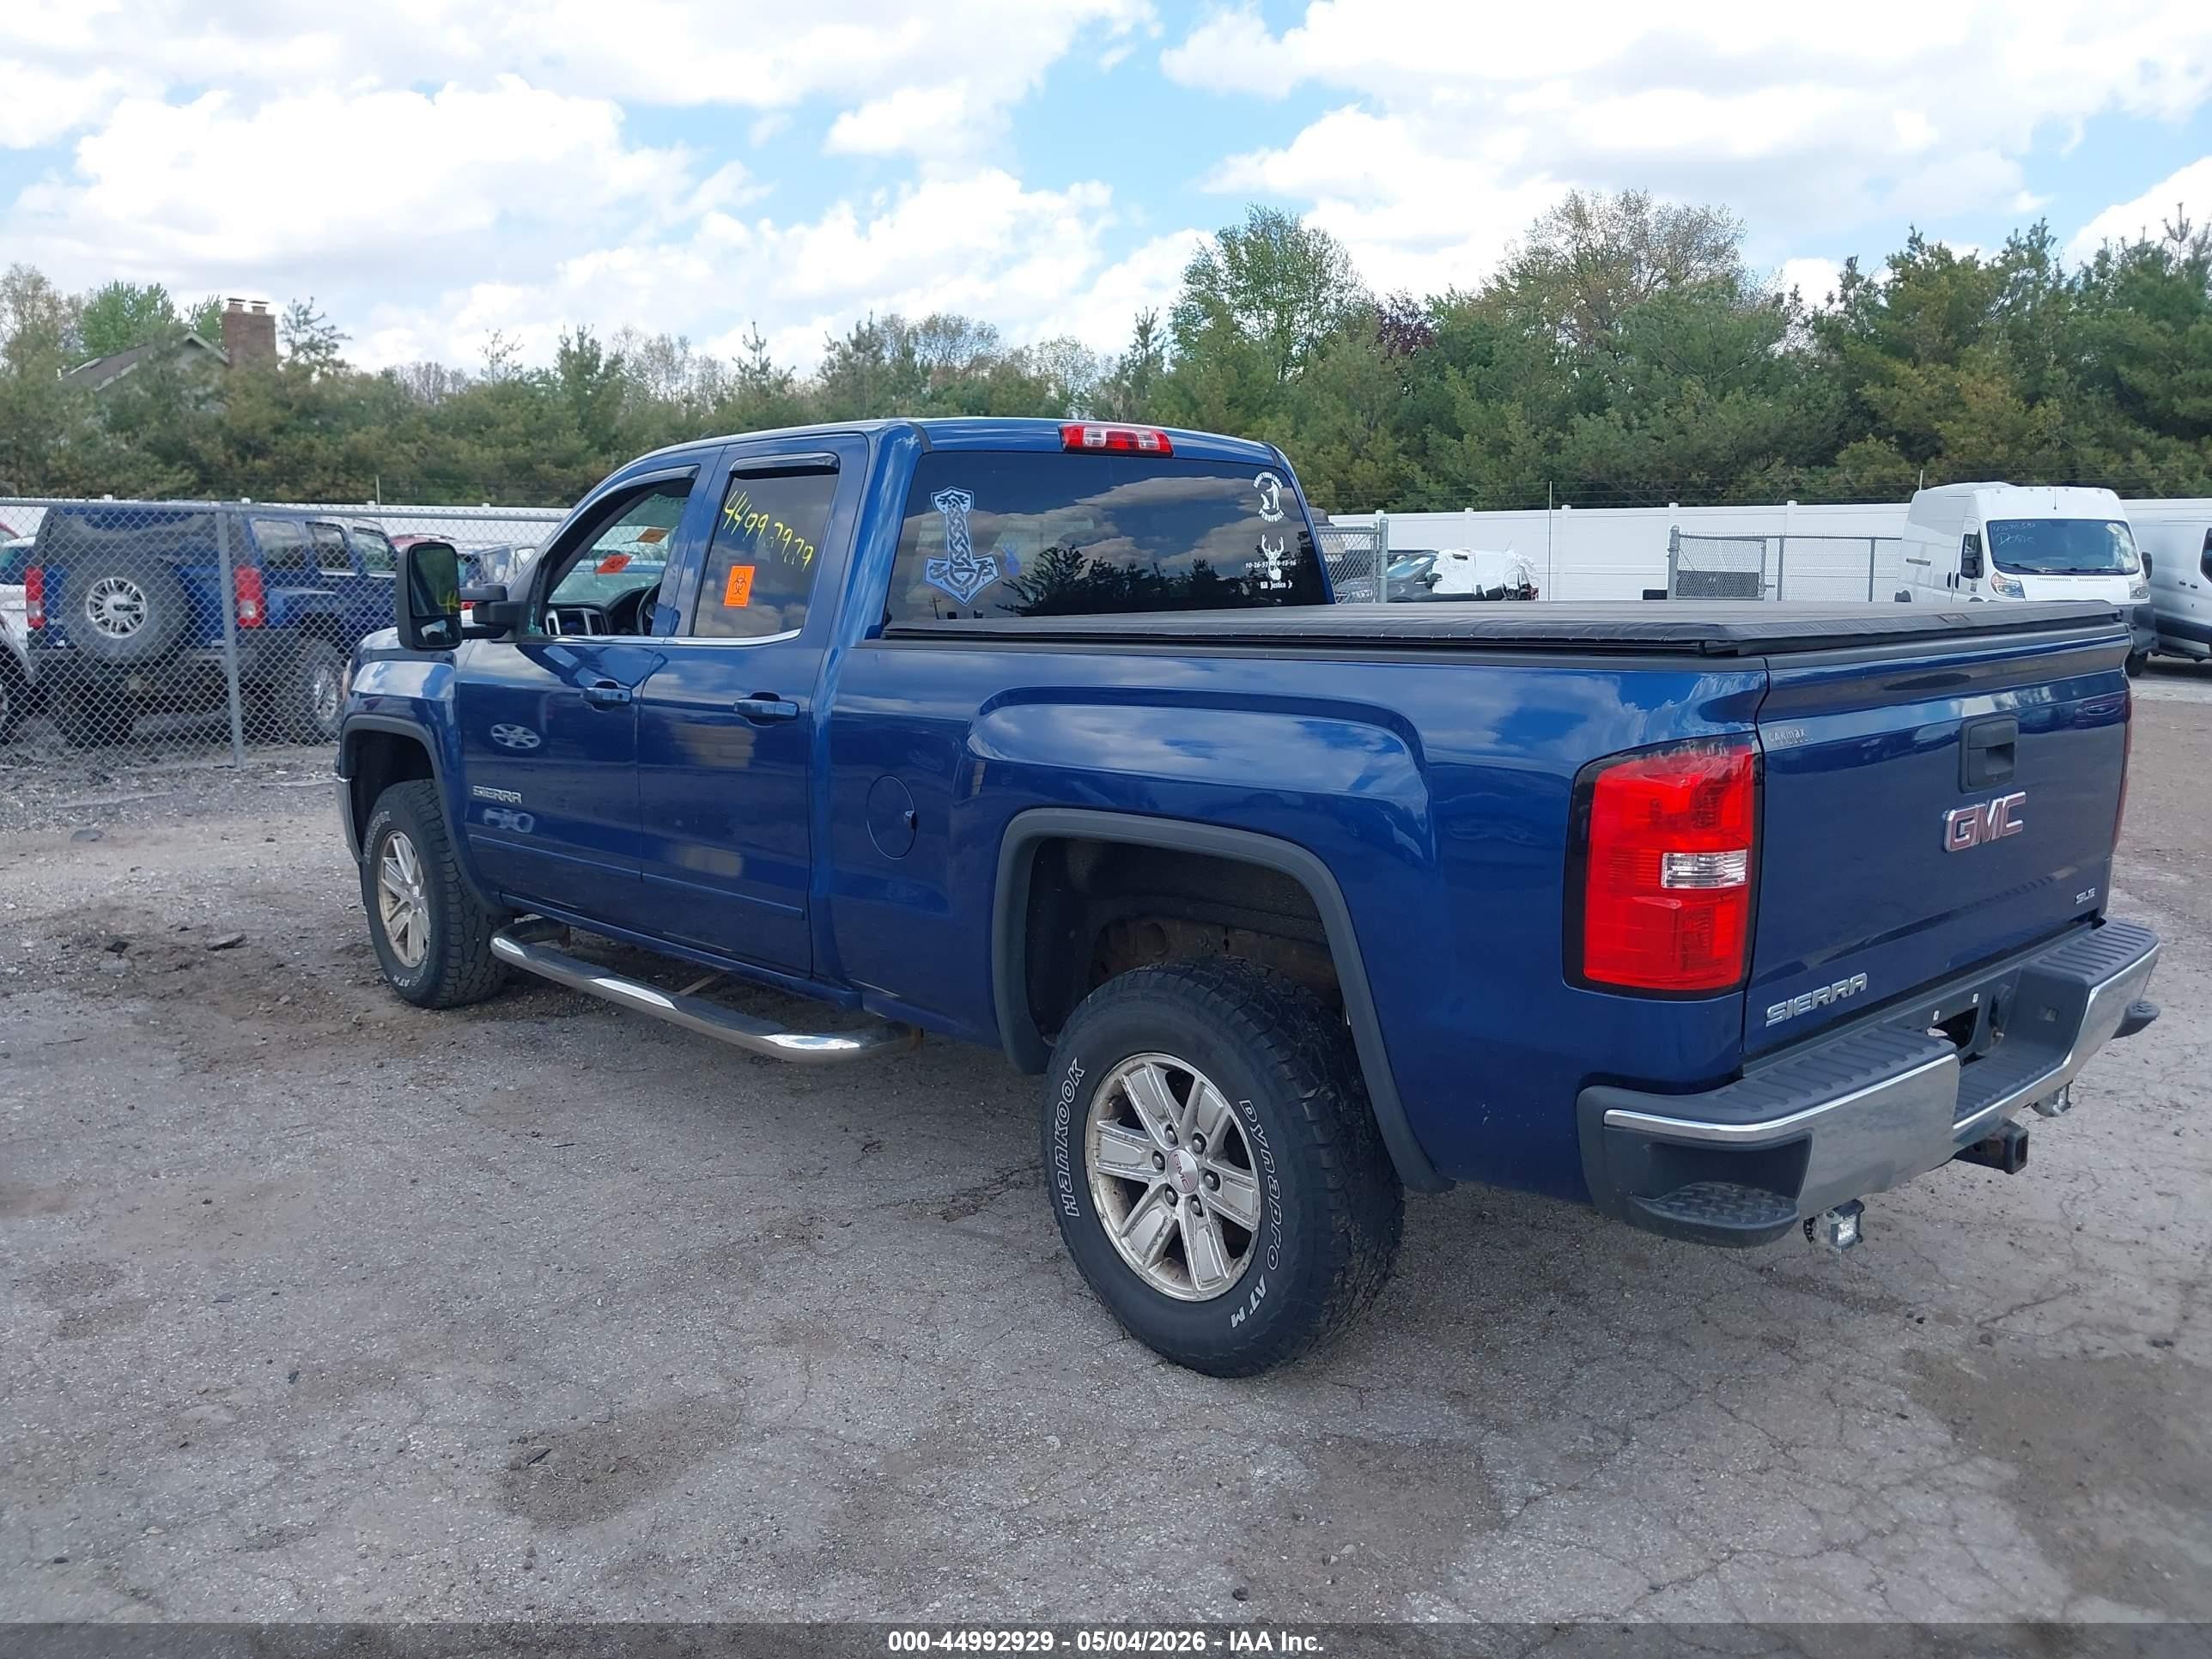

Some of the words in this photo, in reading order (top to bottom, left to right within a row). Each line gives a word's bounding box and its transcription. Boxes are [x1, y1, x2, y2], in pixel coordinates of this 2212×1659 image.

[473, 785, 522, 804] SIERRA
[1942, 792, 2027, 852] GMC
[2075, 887, 2096, 904] SLE
[1765, 972, 1869, 1028] SIERRA
[1173, 1153, 1191, 1190] GMC
